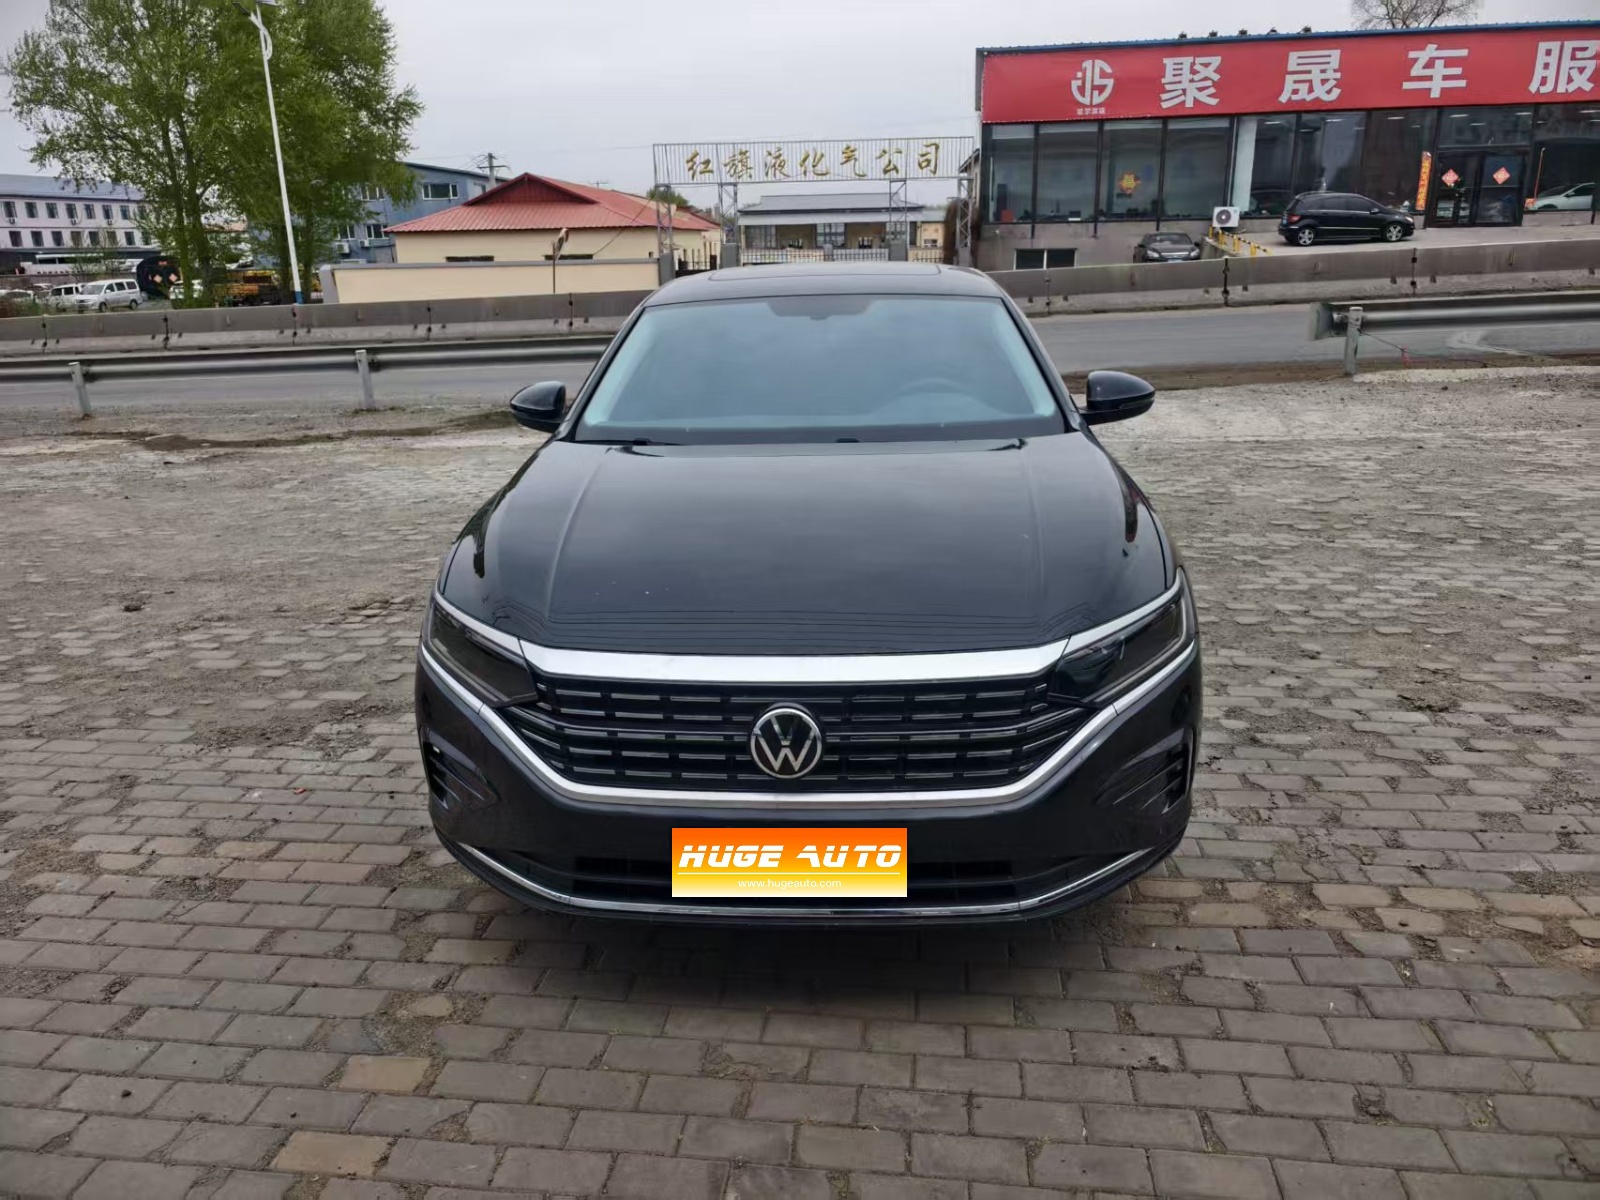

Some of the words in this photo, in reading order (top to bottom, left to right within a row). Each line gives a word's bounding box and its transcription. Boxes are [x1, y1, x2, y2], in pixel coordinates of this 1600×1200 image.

[1160, 41, 1600, 109] 聚晟车服
[685, 142, 940, 181] 红旗液化气公司
